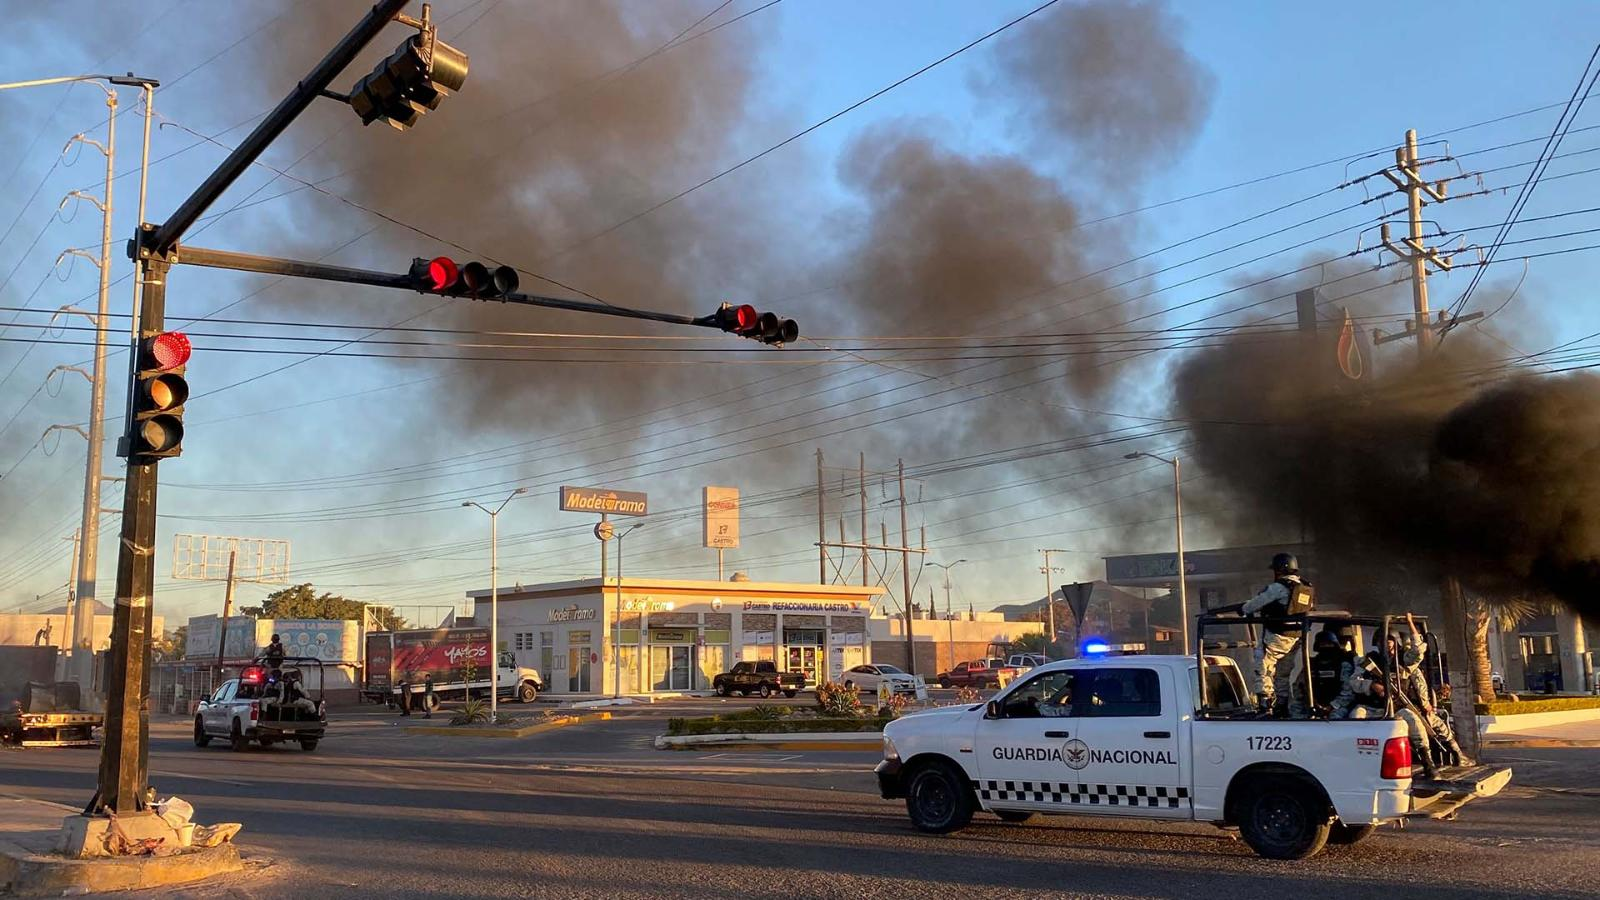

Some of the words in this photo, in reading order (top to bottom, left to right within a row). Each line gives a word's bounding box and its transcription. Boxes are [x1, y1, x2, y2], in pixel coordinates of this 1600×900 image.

[772, 602, 823, 611] REFACCIONARIA
[825, 603, 849, 612] CASTRO
[1246, 736, 1292, 750] 17223
[993, 747, 1063, 761] GUARDIA
[1091, 750, 1177, 765] NACIONAL
